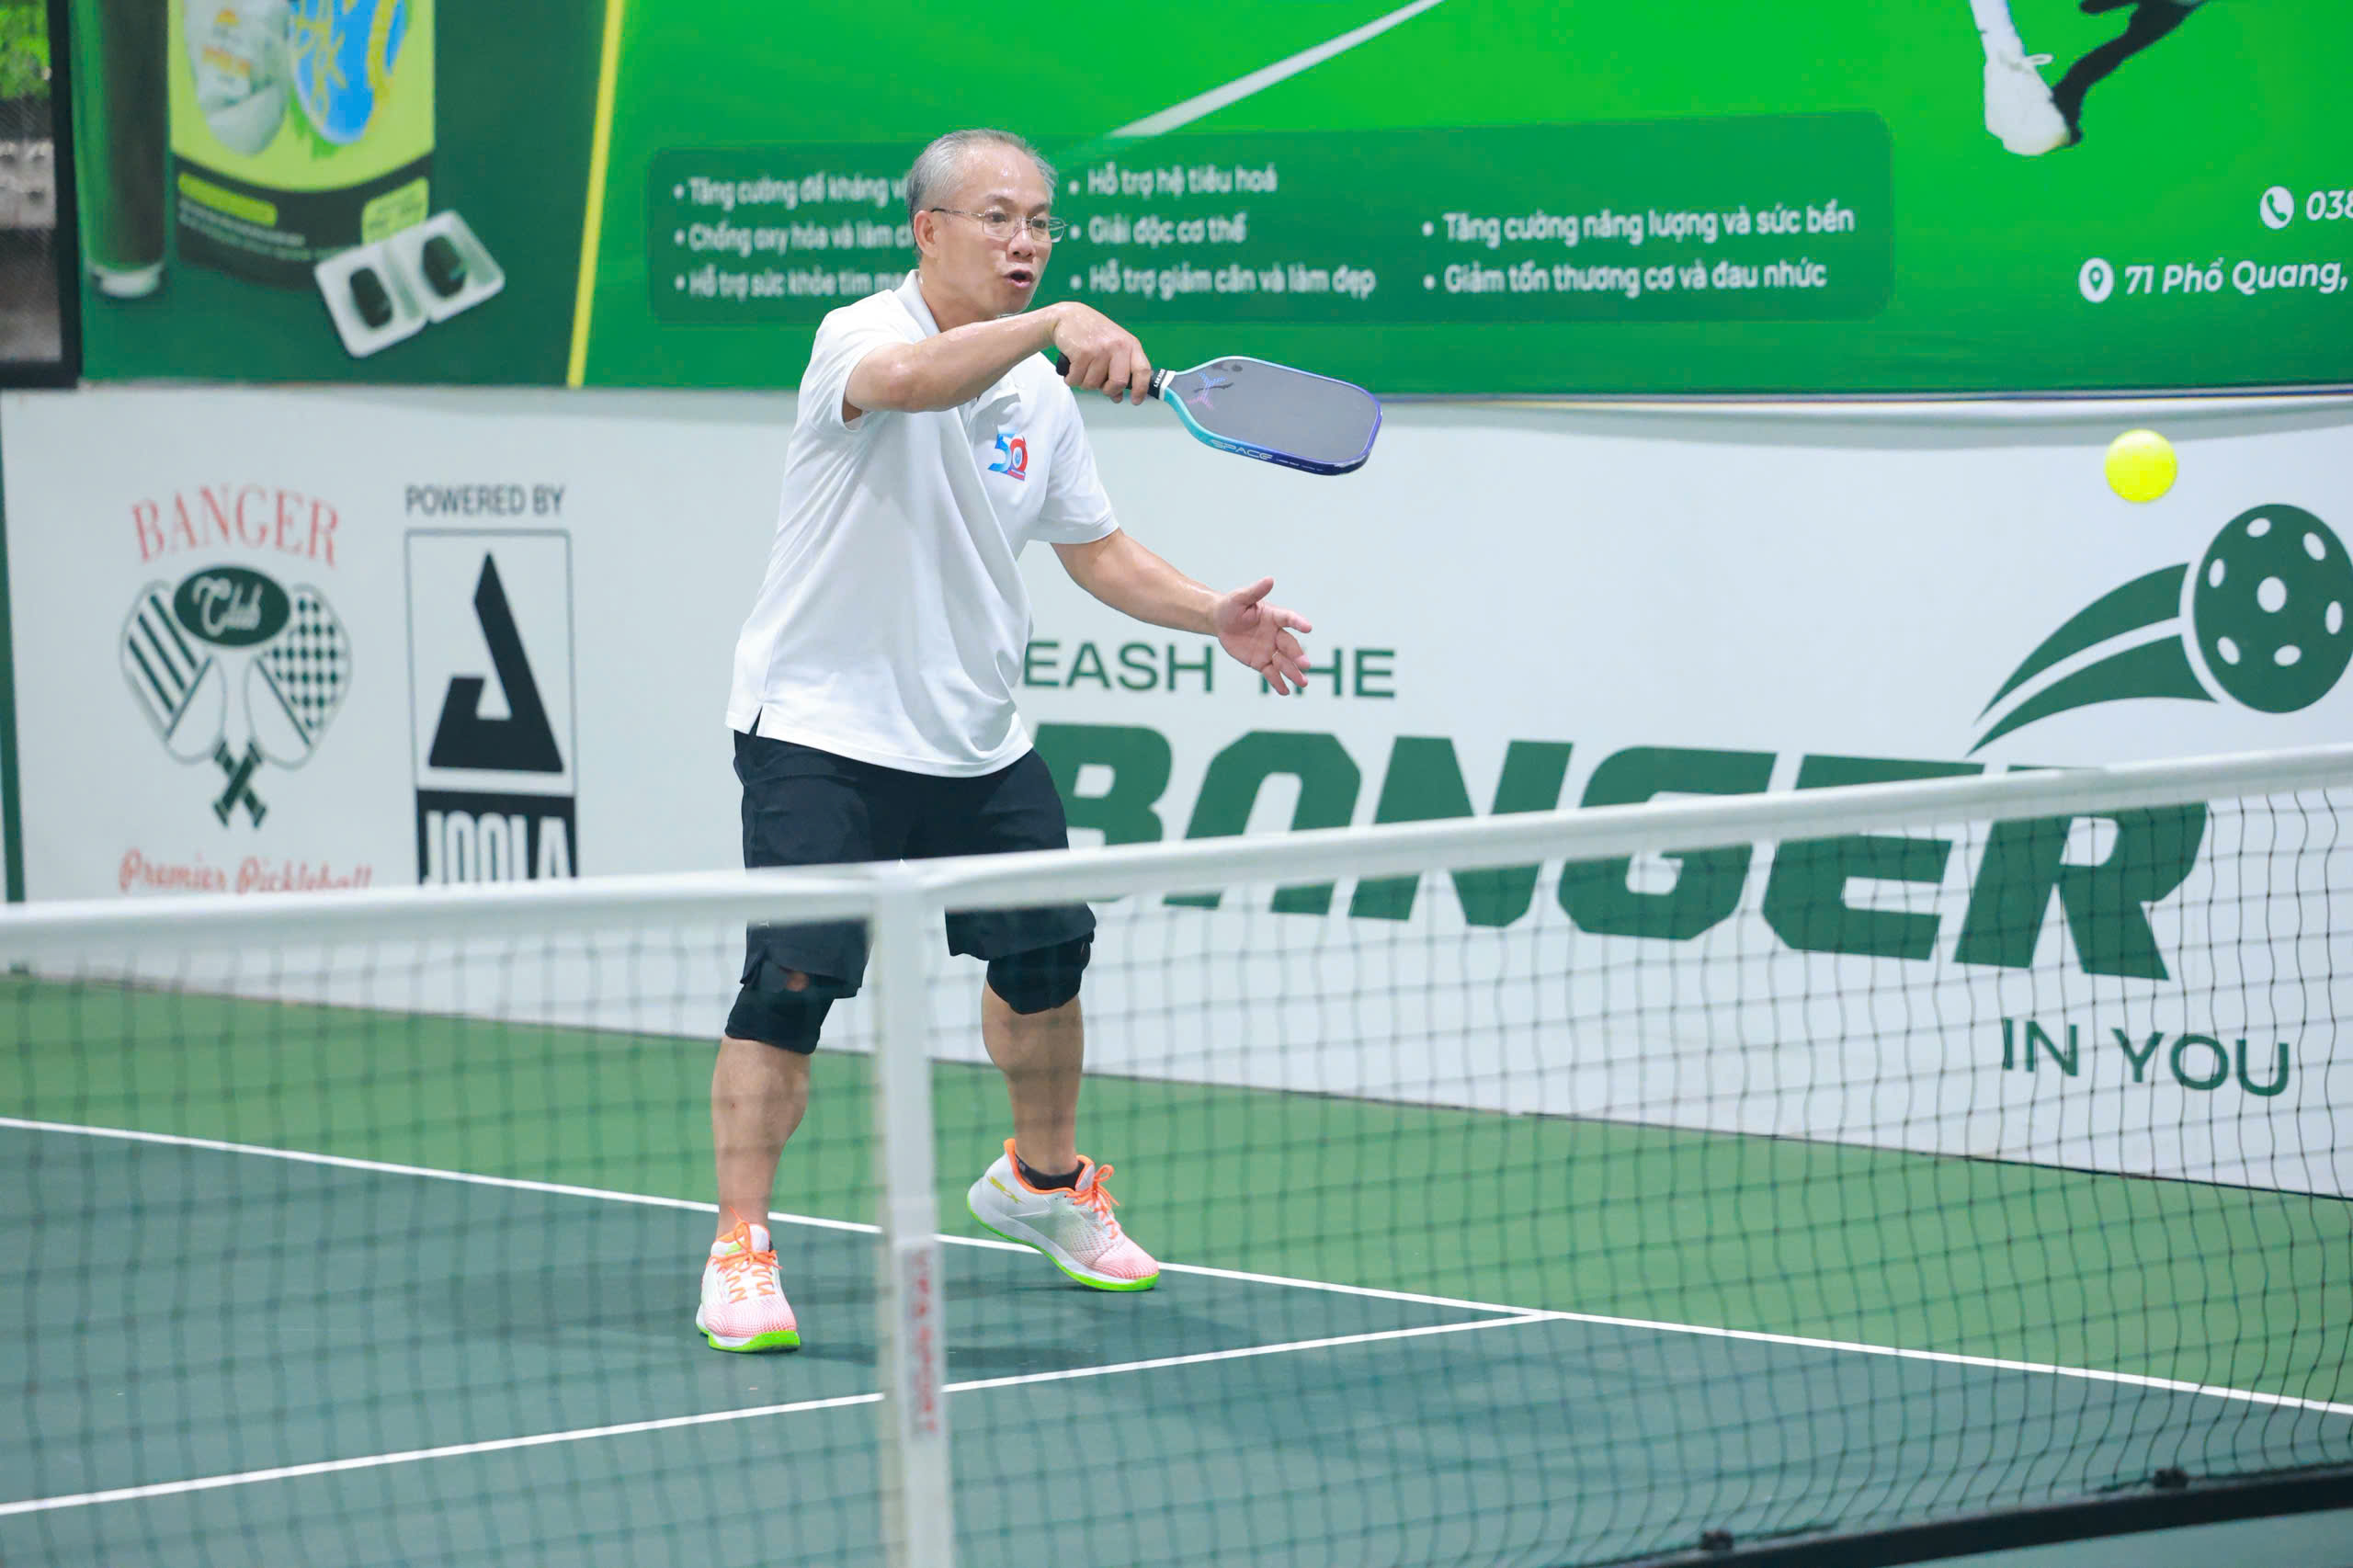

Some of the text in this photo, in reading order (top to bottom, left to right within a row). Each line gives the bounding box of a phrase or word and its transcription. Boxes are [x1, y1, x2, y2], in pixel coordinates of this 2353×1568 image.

[1442, 210, 1501, 249] Tăng
[1504, 207, 1580, 247] cường
[1583, 207, 1644, 245] năng
[1648, 209, 1719, 244] lượng
[1722, 204, 1751, 235] và
[1756, 201, 1802, 234] sức
[1444, 259, 1506, 294] Giảm
[1552, 264, 1642, 300] thương
[1643, 264, 1677, 291] cơ
[1678, 257, 1709, 290] và
[1711, 261, 1759, 290] đau
[1763, 256, 1828, 289] nhức
[2124, 264, 2155, 295] 71
[2232, 260, 2348, 296] Quang,
[1210, 438, 1274, 461] SPACE
[404, 483, 567, 518] POWERED BY
[131, 483, 340, 570] BANGER
[1022, 640, 1396, 699] EASH HE
[1032, 721, 2208, 981] BANGER
[2002, 1016, 2290, 1097] IN YOU
